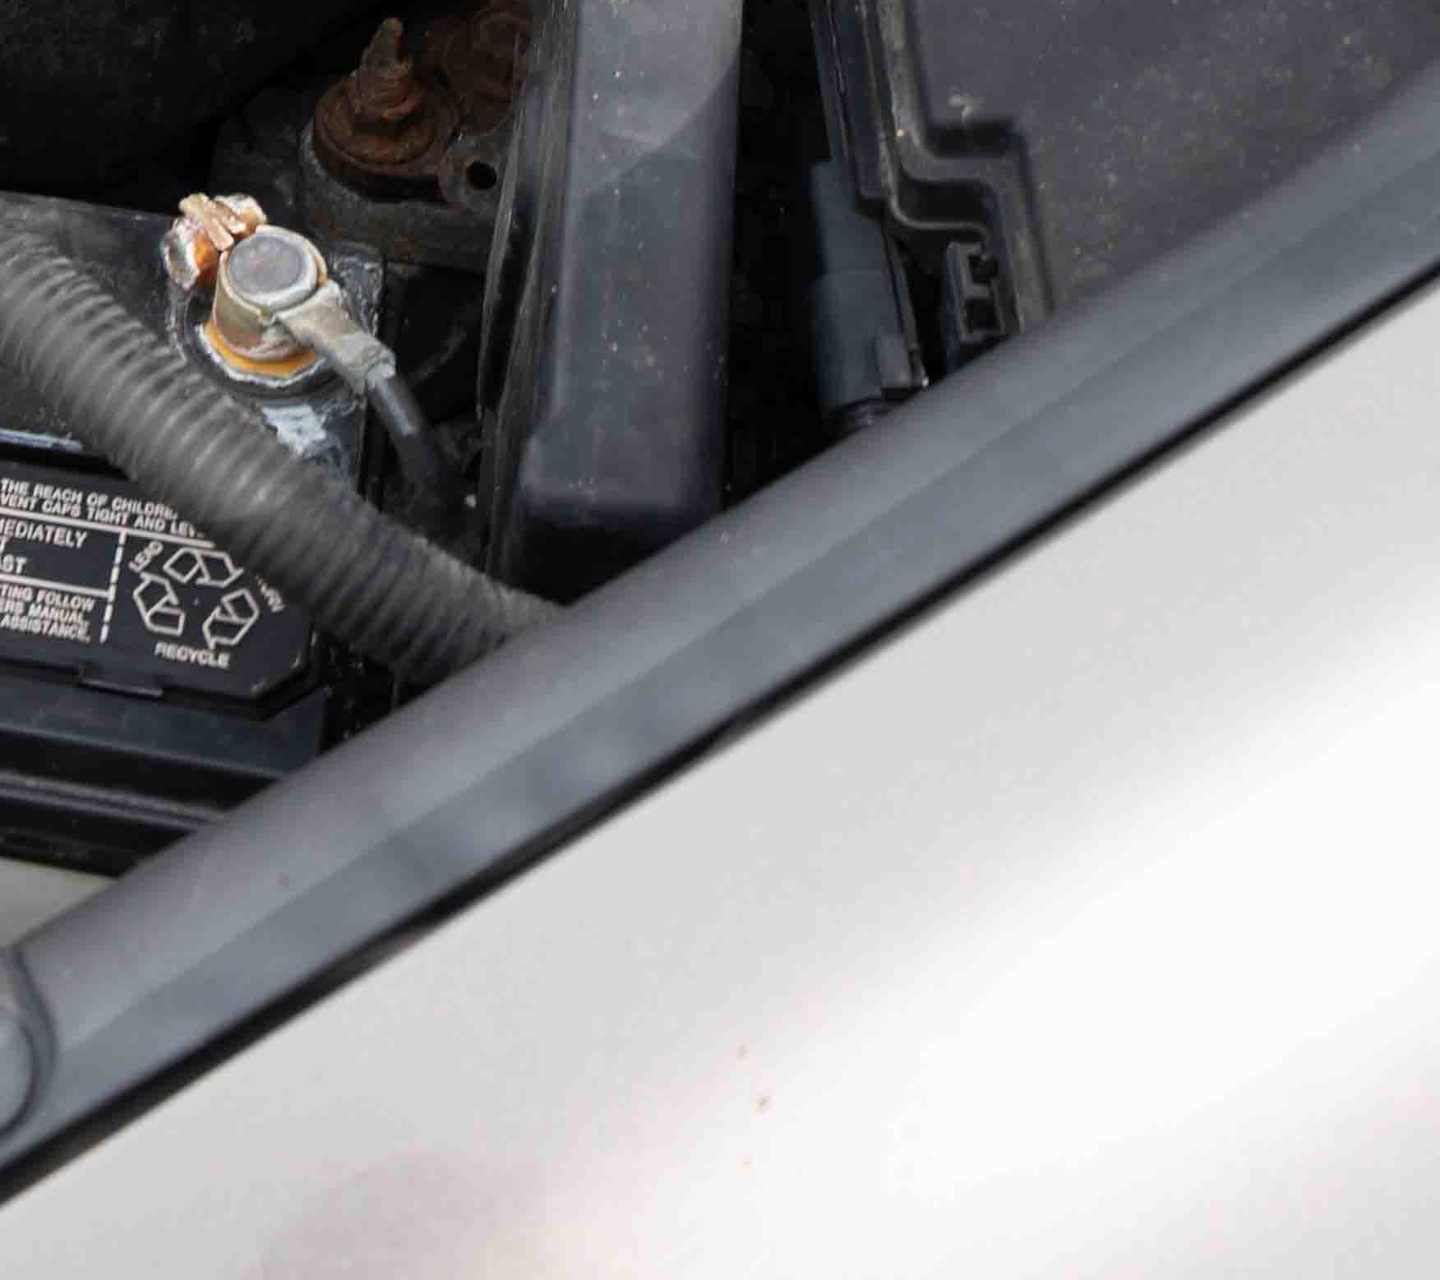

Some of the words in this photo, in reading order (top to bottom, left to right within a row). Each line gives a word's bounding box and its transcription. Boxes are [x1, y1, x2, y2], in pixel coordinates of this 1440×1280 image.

[1, 478, 31, 497] THE
[33, 483, 83, 505] REACH
[87, 492, 108, 508] OF
[0, 490, 37, 512] VENT
[42, 499, 82, 519] CAPS
[87, 507, 131, 527] TIGHT
[133, 514, 166, 532] AND
[36, 589, 95, 613] FOLLOW
[154, 642, 231, 670] RECYCLE
